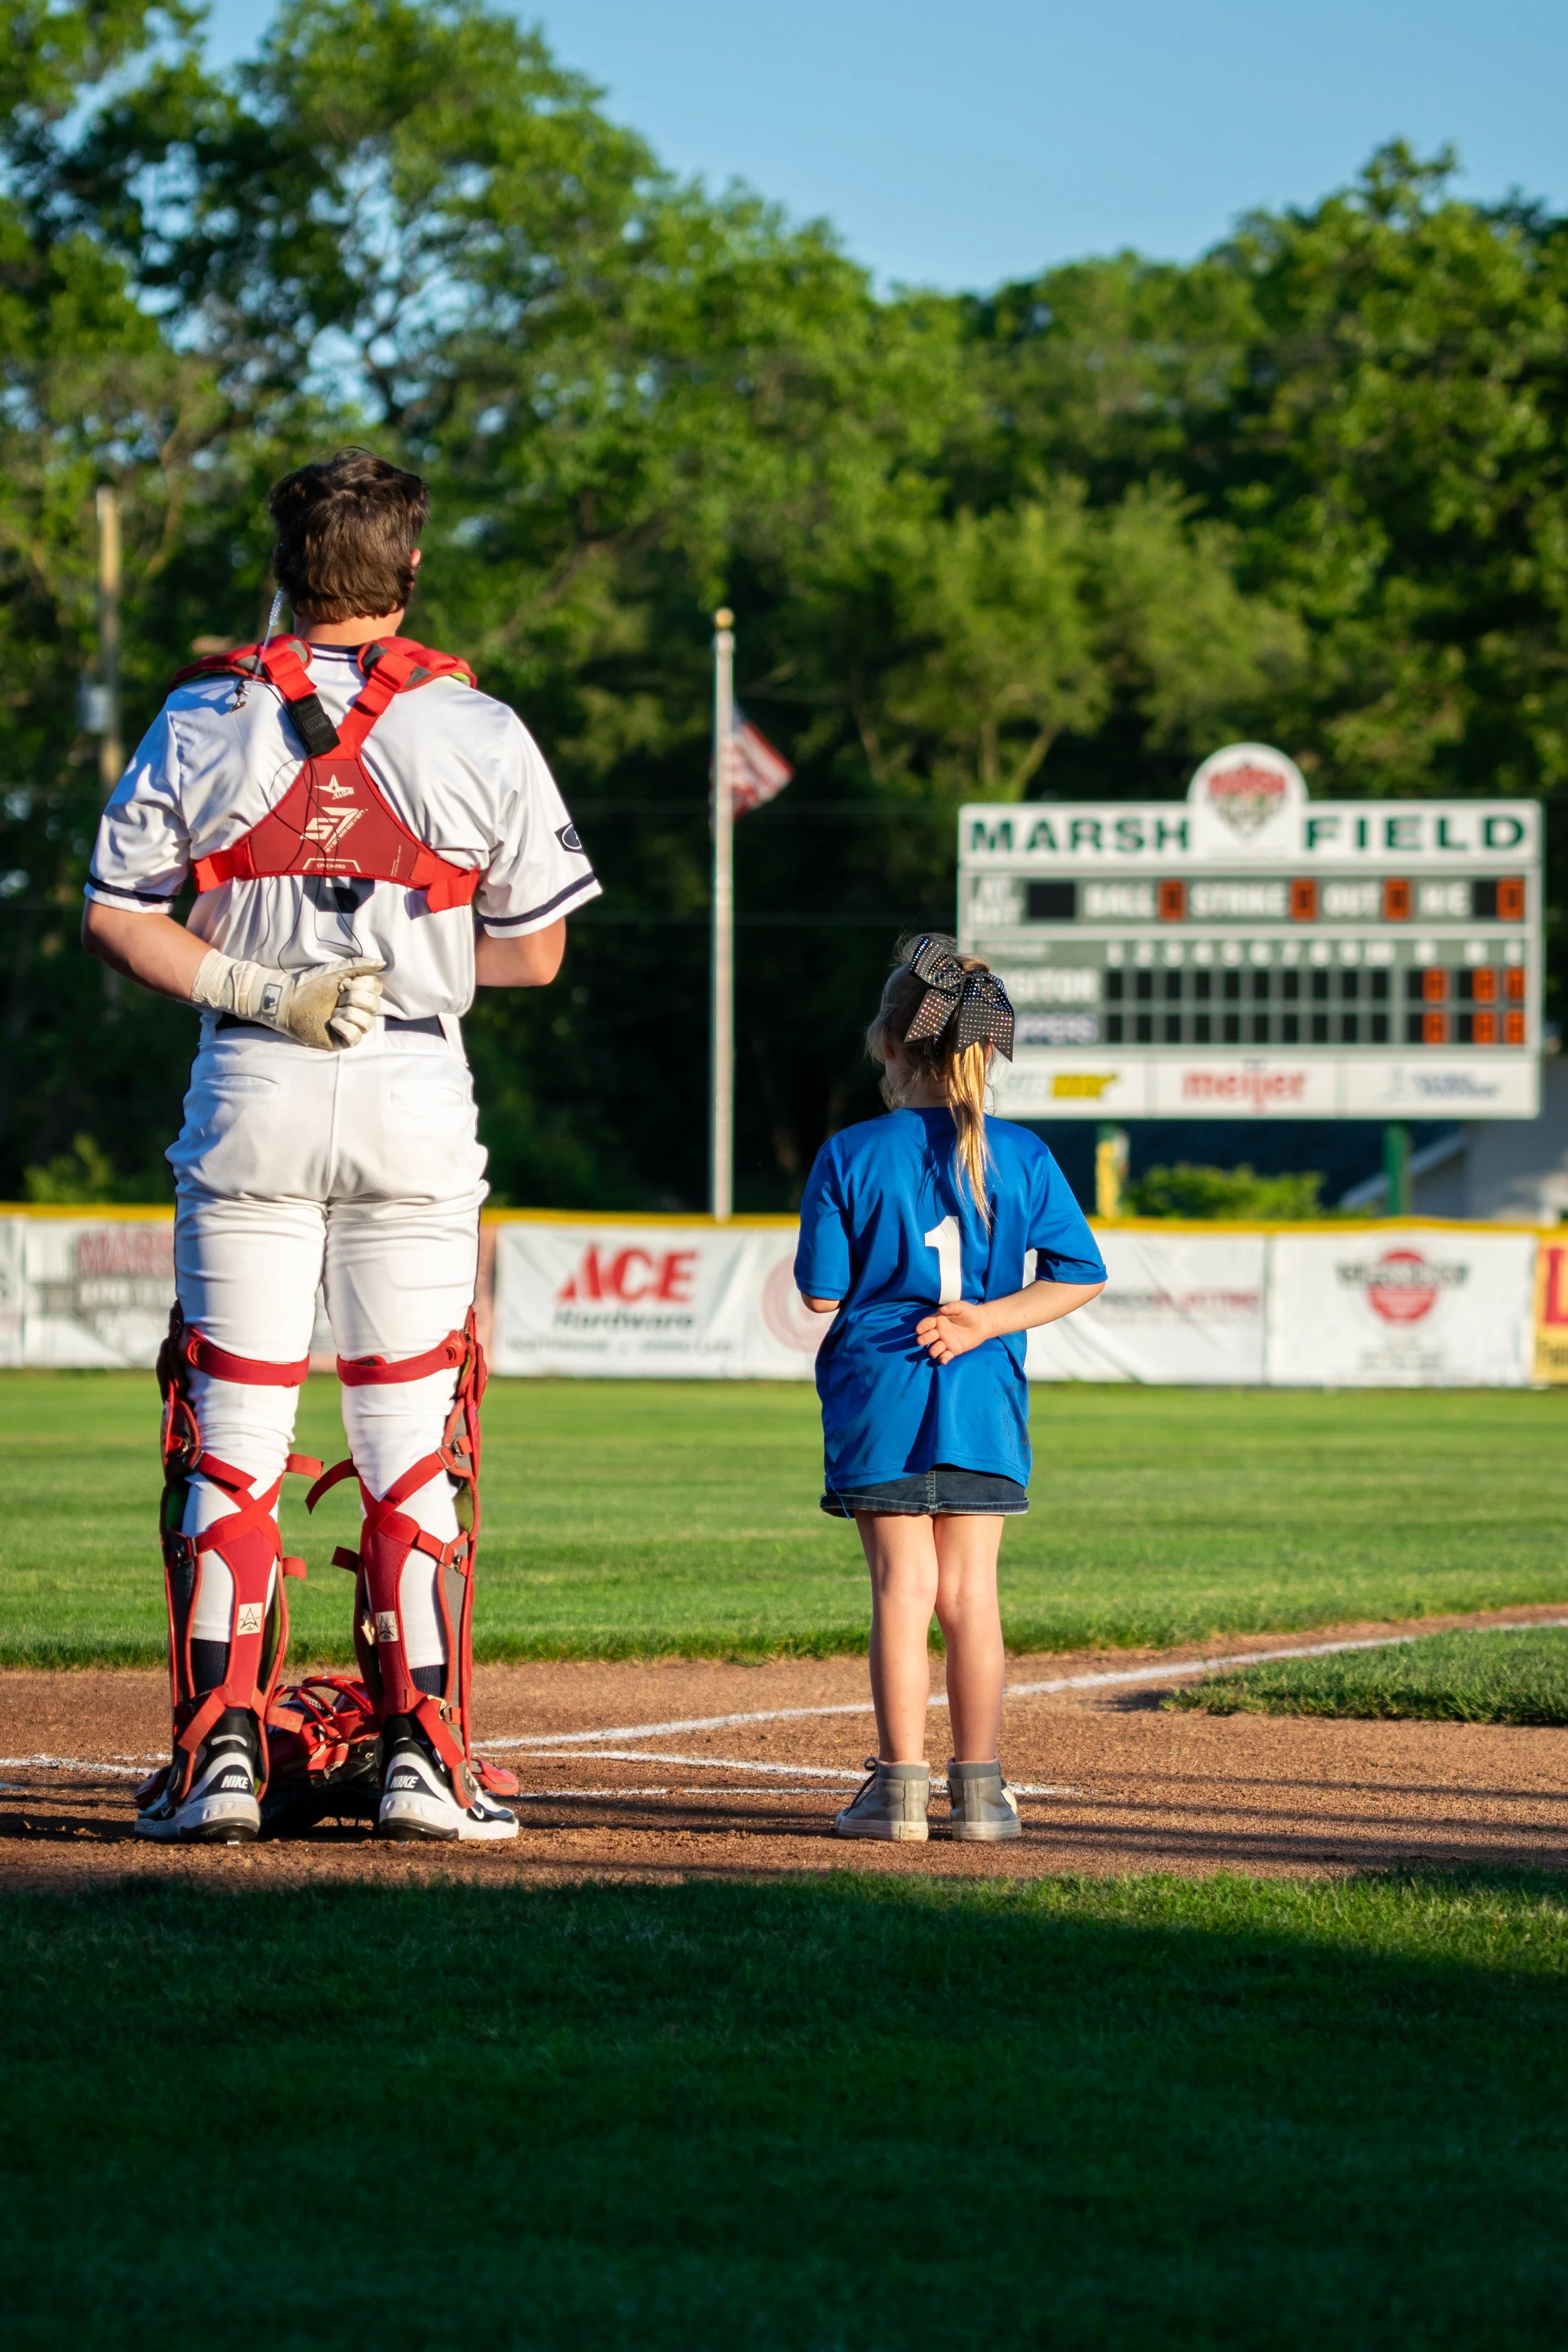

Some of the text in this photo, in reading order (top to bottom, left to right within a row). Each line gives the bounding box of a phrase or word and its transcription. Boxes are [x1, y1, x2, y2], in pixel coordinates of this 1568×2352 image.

[969, 814, 1527, 853] MARSH FIELD
[1084, 883, 1153, 917] BALL
[1192, 882, 1286, 916] STRIKE
[1323, 882, 1380, 916] OUT
[556, 1243, 699, 1304] ACE
[924, 1216, 962, 1305] 1
[554, 1309, 694, 1330] Hardware
[221, 1775, 248, 1789] NIKE
[389, 1775, 419, 1789] NIKE
